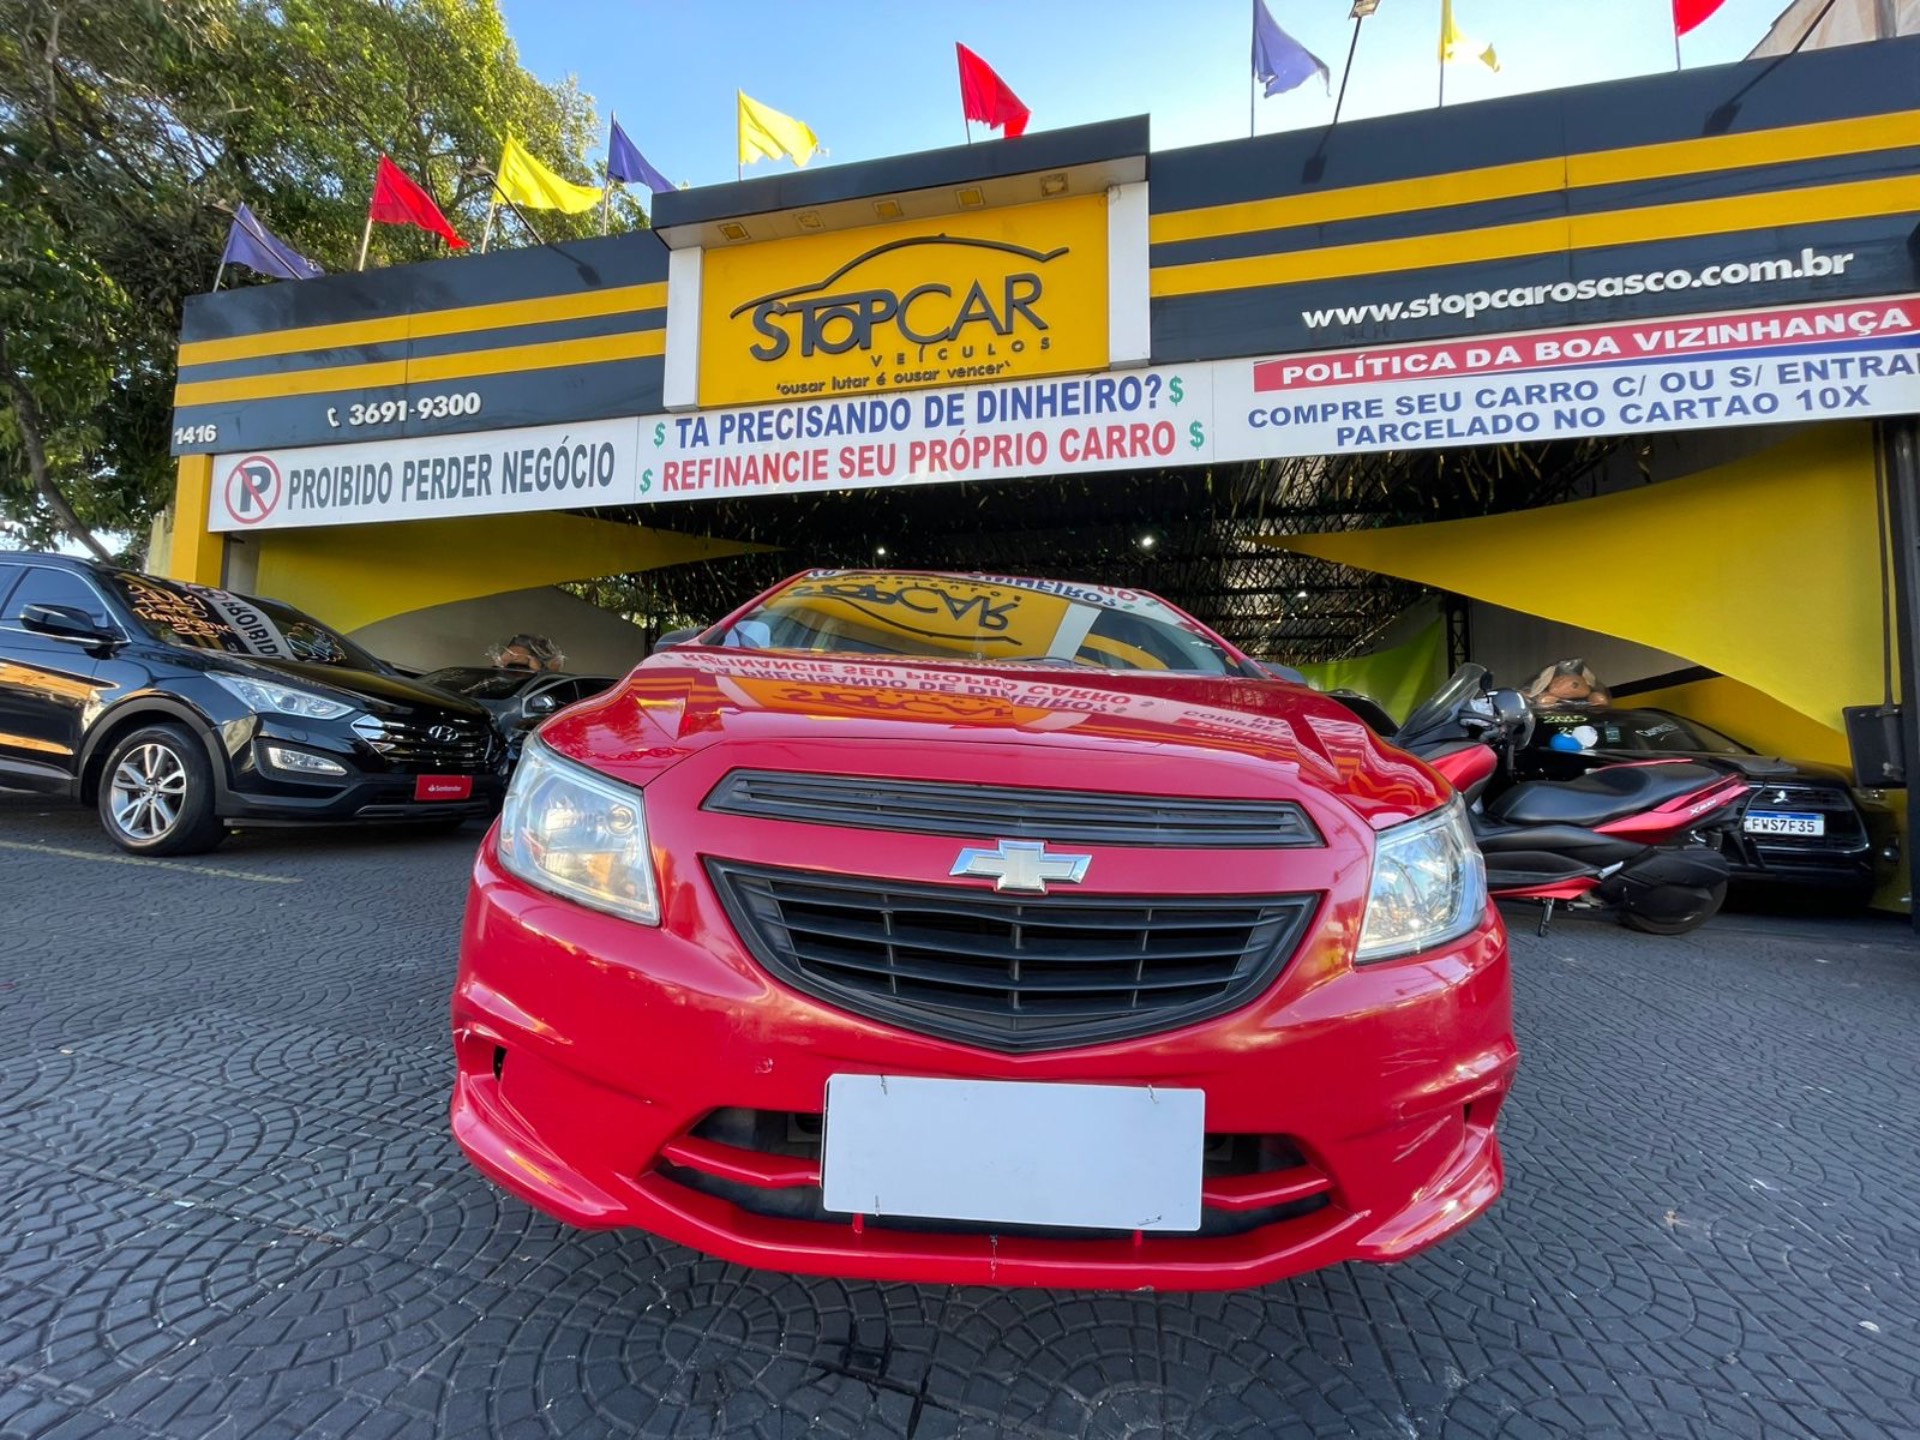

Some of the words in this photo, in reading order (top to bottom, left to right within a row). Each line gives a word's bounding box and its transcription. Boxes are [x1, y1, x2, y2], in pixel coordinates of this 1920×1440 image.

[749, 273, 1049, 361] STOPCAR
[1302, 248, 1854, 328] www.stopcarosasco.com.br
[832, 375, 870, 391] lutar
[876, 371, 886, 386] é
[894, 369, 940, 384] ousar
[871, 337, 1050, 367] VEÍCULOS
[1282, 351, 1457, 385] POLÍTICA
[1466, 345, 1521, 368] DA
[1535, 336, 1621, 362] BOA
[1632, 308, 1912, 352] VIZINHANÇA
[349, 392, 481, 426] 3691-9300
[675, 416, 710, 449] TA
[719, 397, 912, 445] PRECISANDO
[924, 393, 965, 429] DE
[977, 374, 1162, 424] DINHEIRO?
[1248, 398, 1383, 428] COMPRE
[1395, 391, 1462, 416] SEU
[1475, 380, 1598, 409] CARRO
[1612, 374, 1646, 397] C/
[1660, 369, 1714, 394] OU
[1730, 364, 1762, 388] S/
[1777, 353, 1920, 384] ENTRA
[1336, 412, 1540, 446] PARCELADO
[1554, 406, 1605, 430] NO
[1620, 392, 1779, 425] CARTAO
[1796, 384, 1871, 411] 10X
[174, 424, 217, 445] 1416
[662, 449, 829, 492] REFINANCIE
[838, 443, 896, 479] SEU
[909, 429, 1048, 474] PRÓPRIO
[1059, 420, 1176, 463] CARRO
[288, 462, 393, 510] PROIBIDO
[402, 453, 492, 502] PERDER
[501, 435, 615, 495] NEGÓCIO
[1752, 819, 1816, 833] FWS7F35
